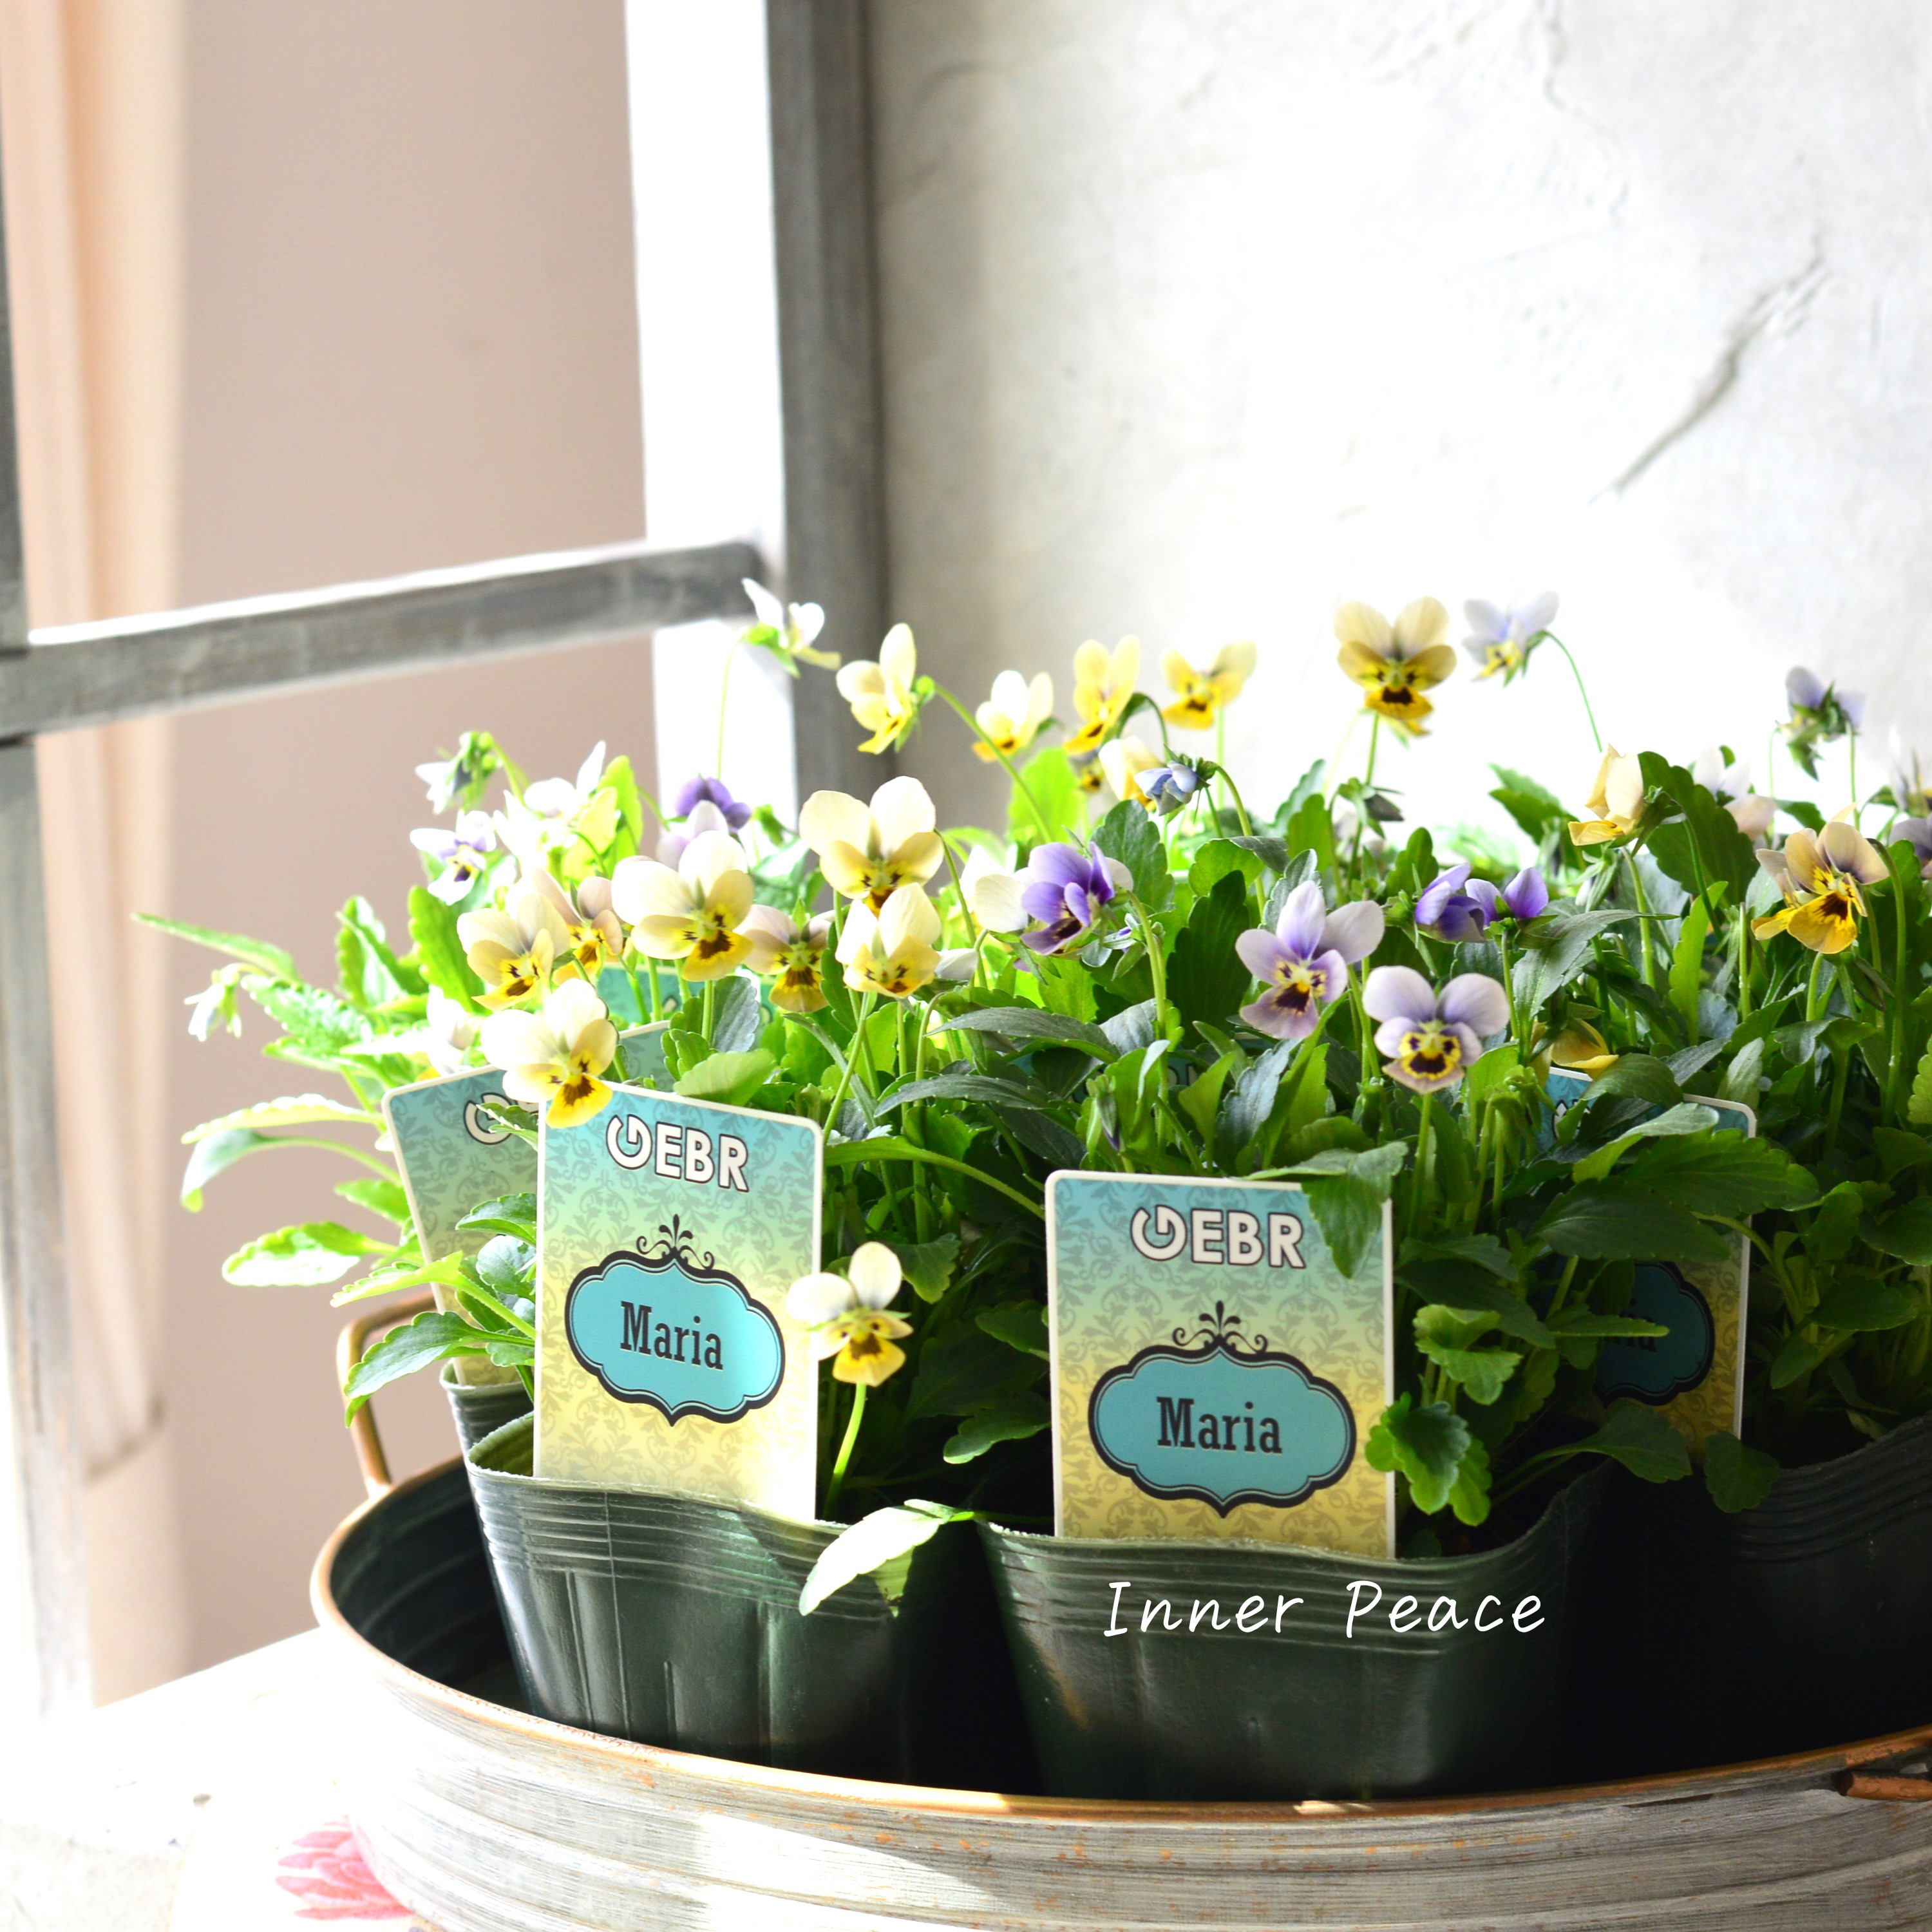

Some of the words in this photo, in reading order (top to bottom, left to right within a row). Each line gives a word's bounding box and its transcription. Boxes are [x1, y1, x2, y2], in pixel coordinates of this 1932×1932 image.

[606, 1114, 748, 1193] GEBR
[1130, 1204, 1306, 1269] GEBR
[620, 1301, 723, 1370] Maria
[1157, 1396, 1282, 1454] Maria
